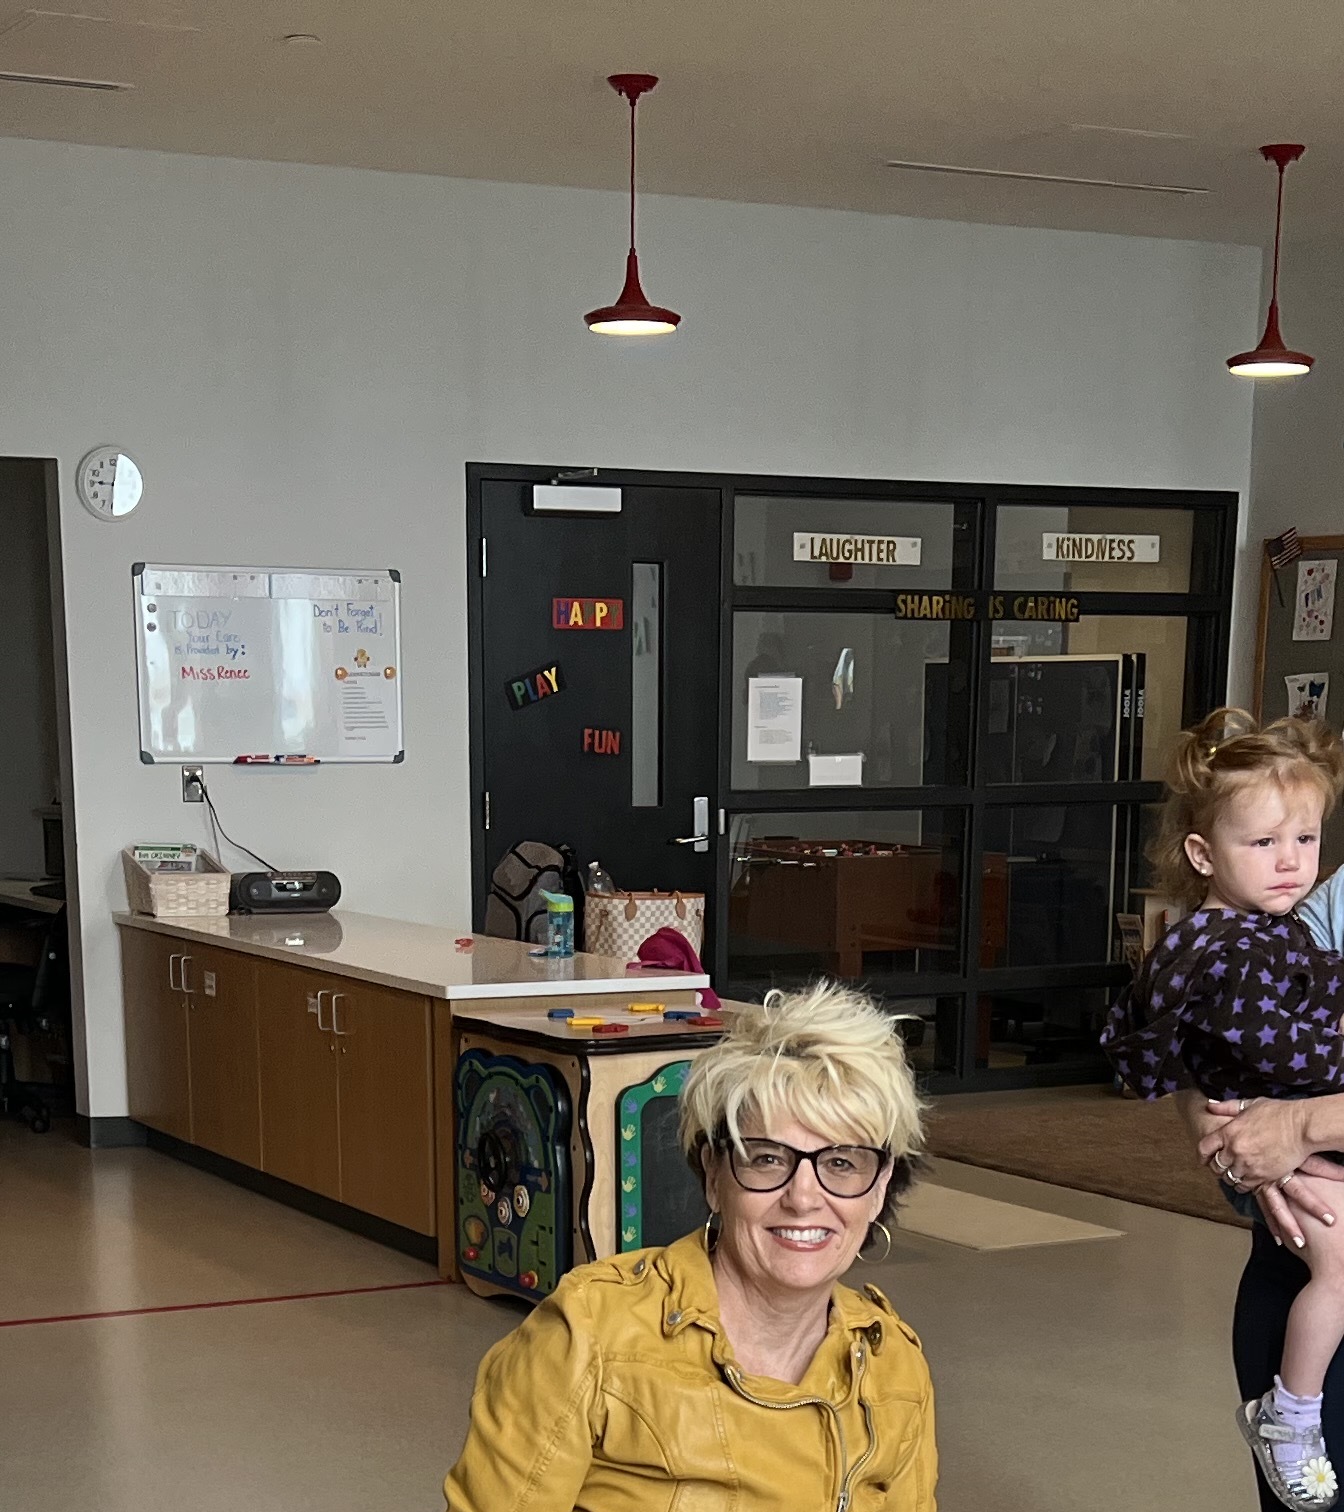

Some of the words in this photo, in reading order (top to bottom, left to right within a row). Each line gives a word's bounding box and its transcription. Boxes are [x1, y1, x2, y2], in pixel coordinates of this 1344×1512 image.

[809, 536, 897, 563] LAUGHTER
[313, 604, 339, 618] Don't
[346, 602, 376, 618] Forget
[557, 601, 621, 627] HAPPY
[988, 595, 1004, 619] IS
[168, 609, 233, 630] TODAY
[322, 622, 332, 633] to
[338, 619, 350, 633] Be
[356, 613, 383, 636] Kind!
[186, 630, 210, 643] Your
[181, 666, 215, 681] Miss
[217, 665, 251, 679] Renee
[512, 666, 559, 706] PLAY
[583, 728, 621, 755] FUN
